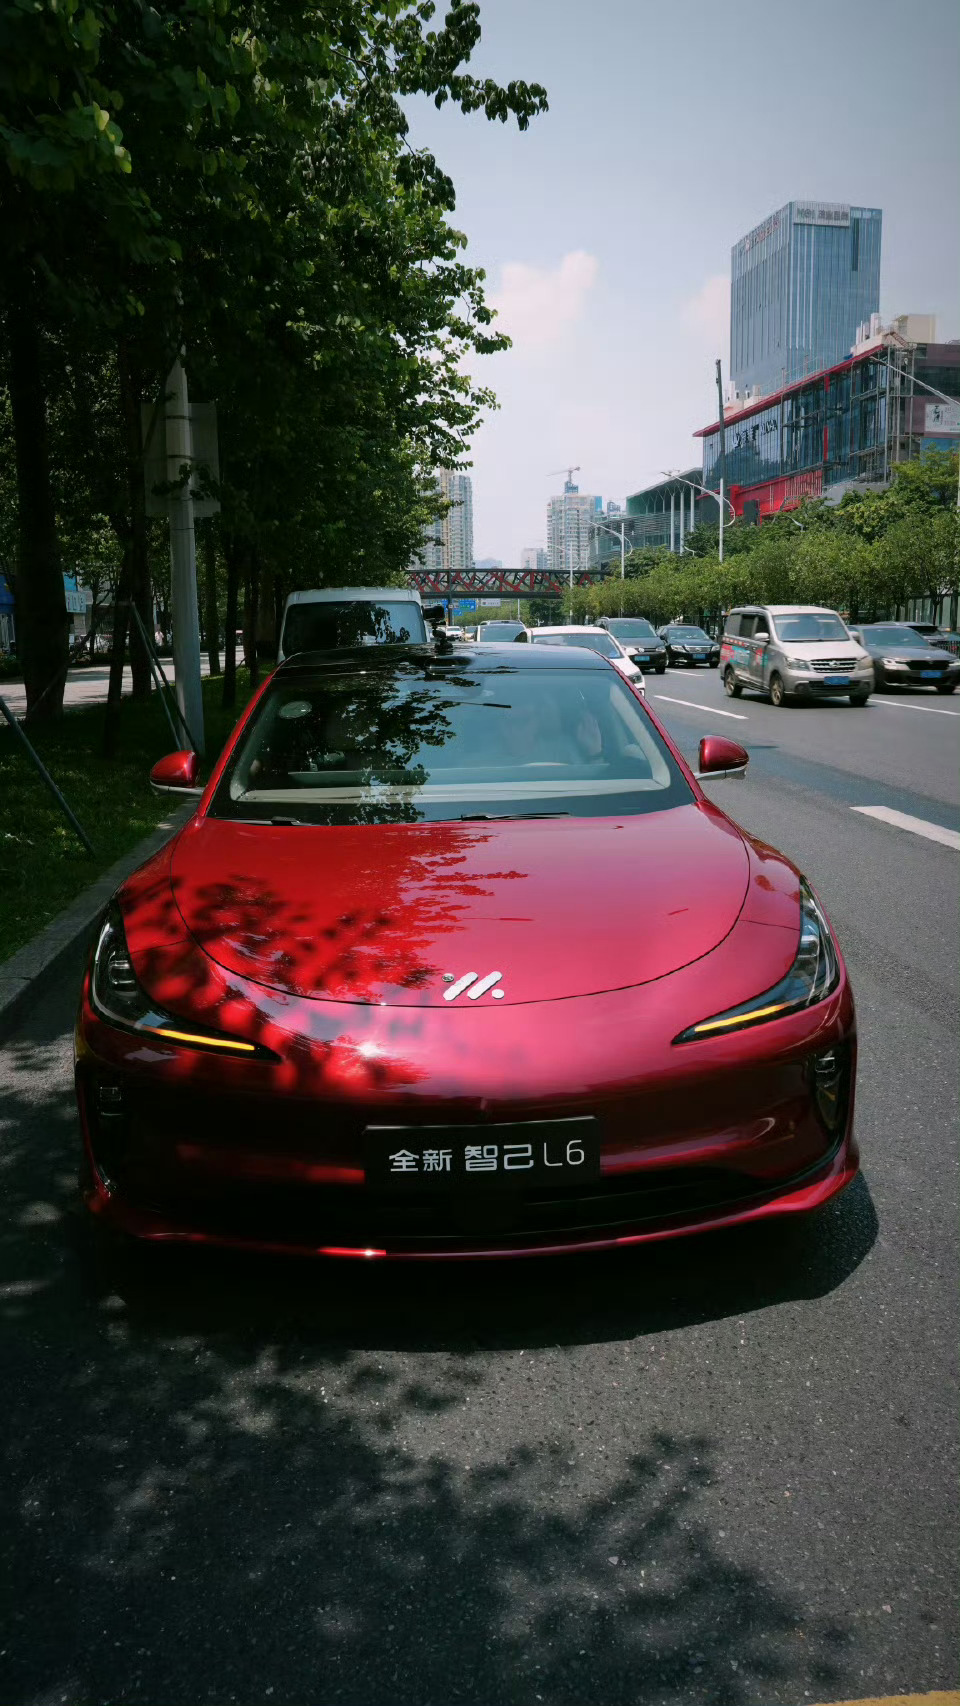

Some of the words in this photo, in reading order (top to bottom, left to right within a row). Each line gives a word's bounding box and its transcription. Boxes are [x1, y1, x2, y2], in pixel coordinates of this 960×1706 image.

[388, 1149, 453, 1172] 全新
[464, 1144, 534, 1172] 智己
[543, 1139, 585, 1167] L6
